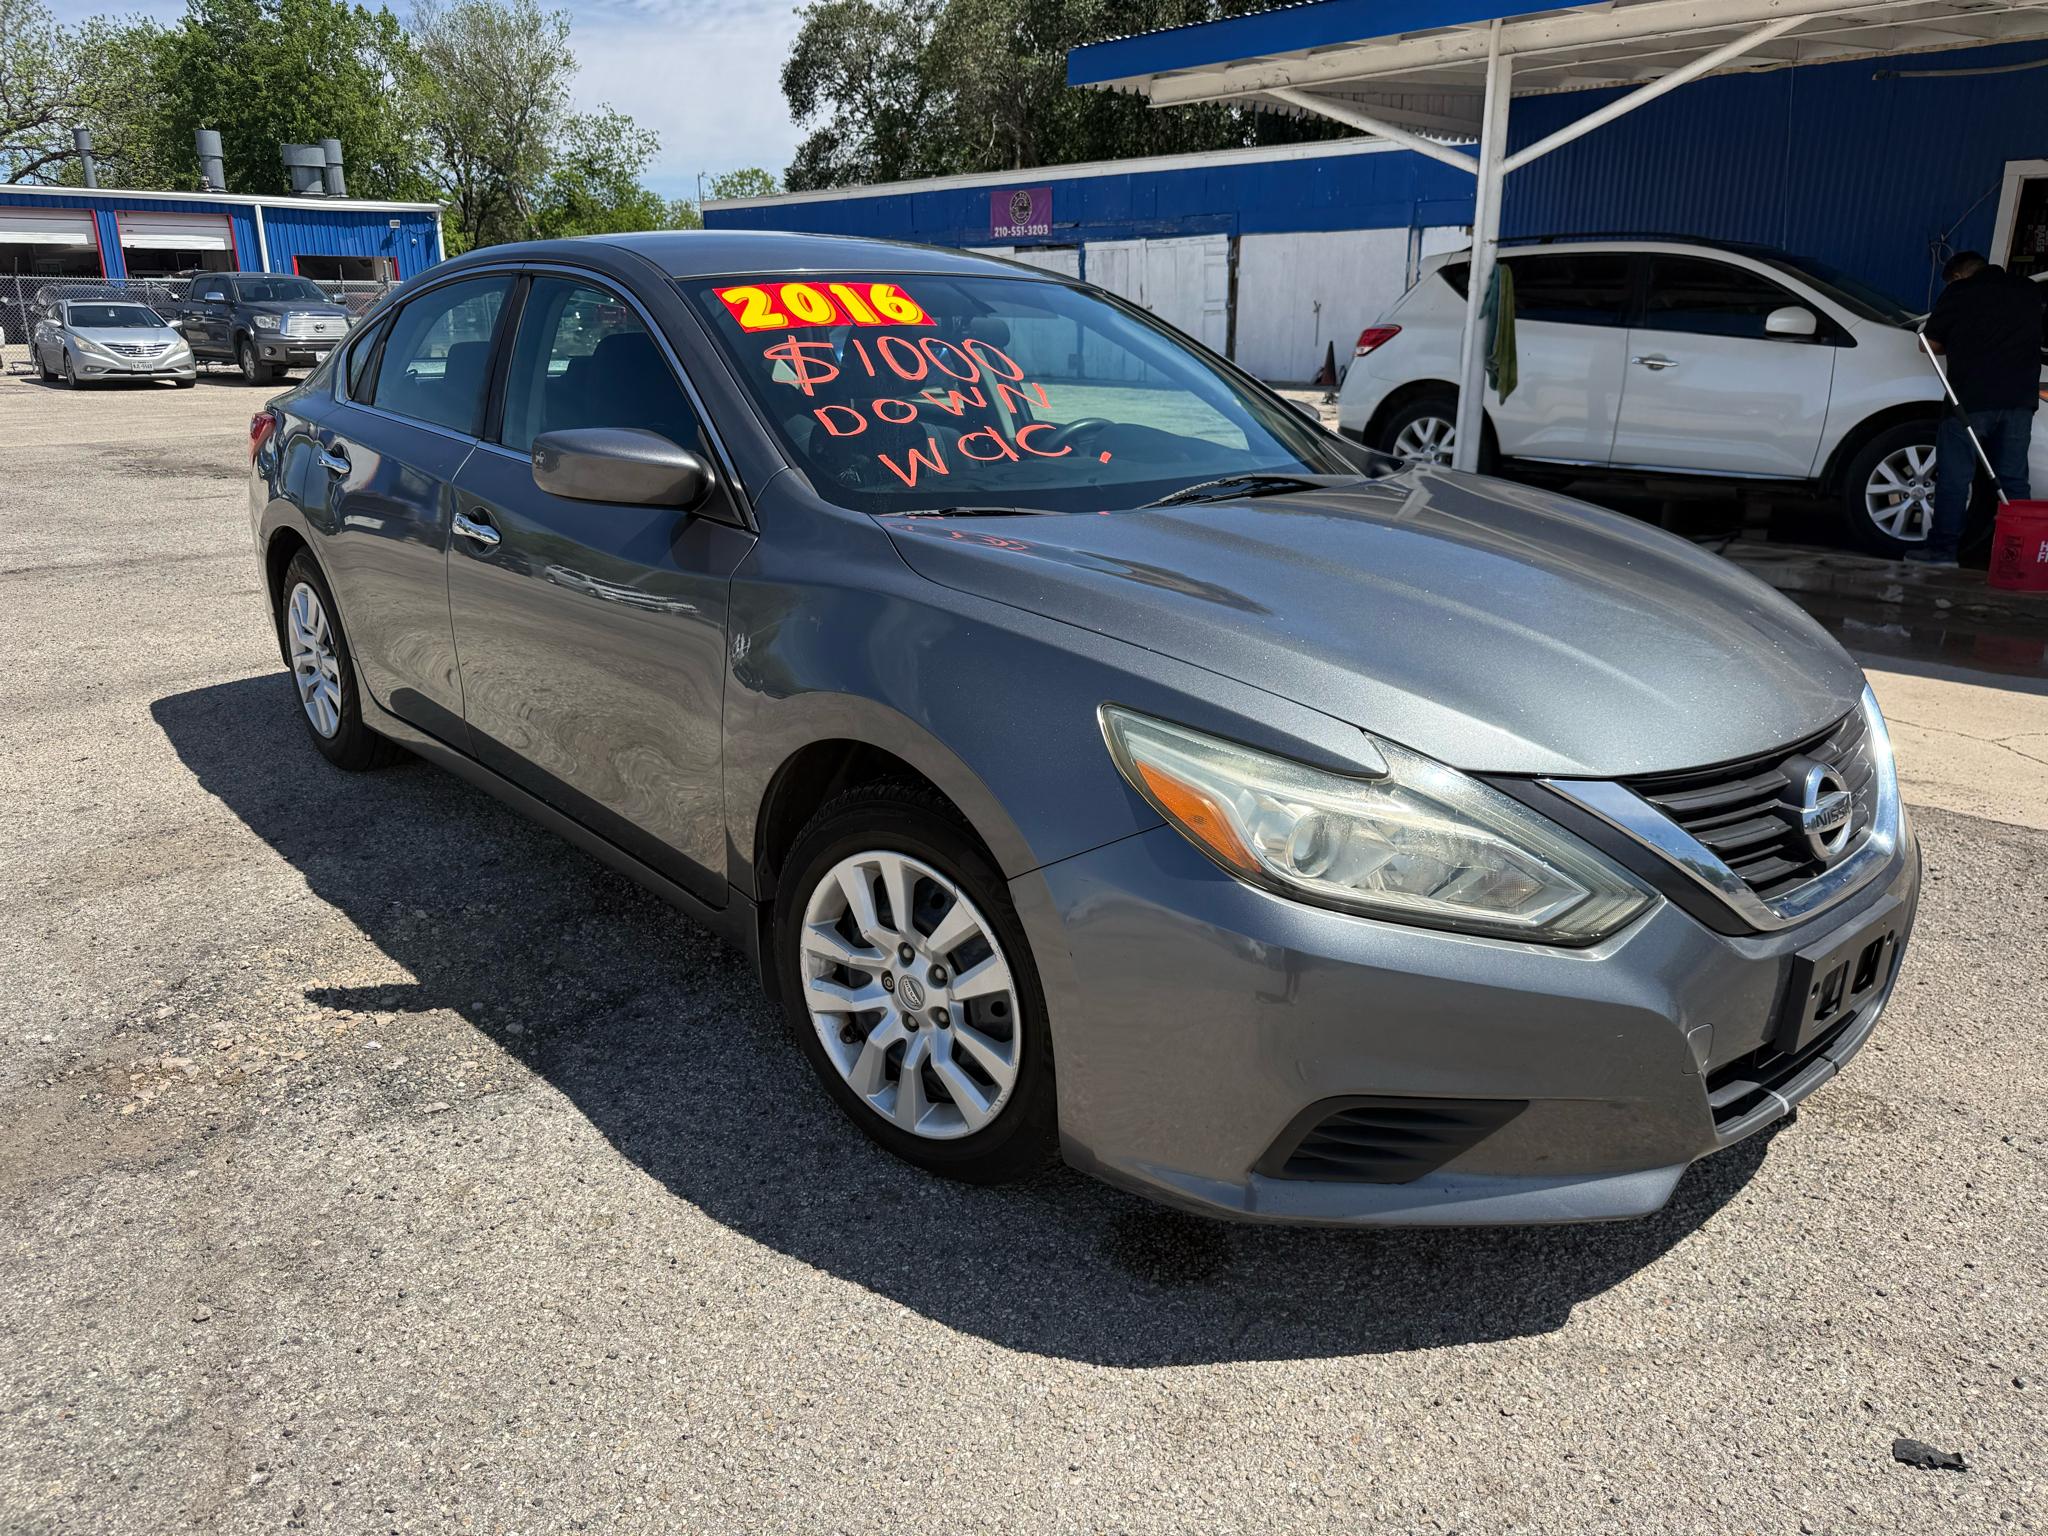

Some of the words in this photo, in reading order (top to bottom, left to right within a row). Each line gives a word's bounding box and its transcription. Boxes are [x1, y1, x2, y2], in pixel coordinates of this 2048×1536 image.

[994, 225, 1049, 238] 210-551-3203
[722, 283, 924, 328] 2016
[763, 335, 1024, 397] $1000
[813, 382, 1052, 436] DOWN
